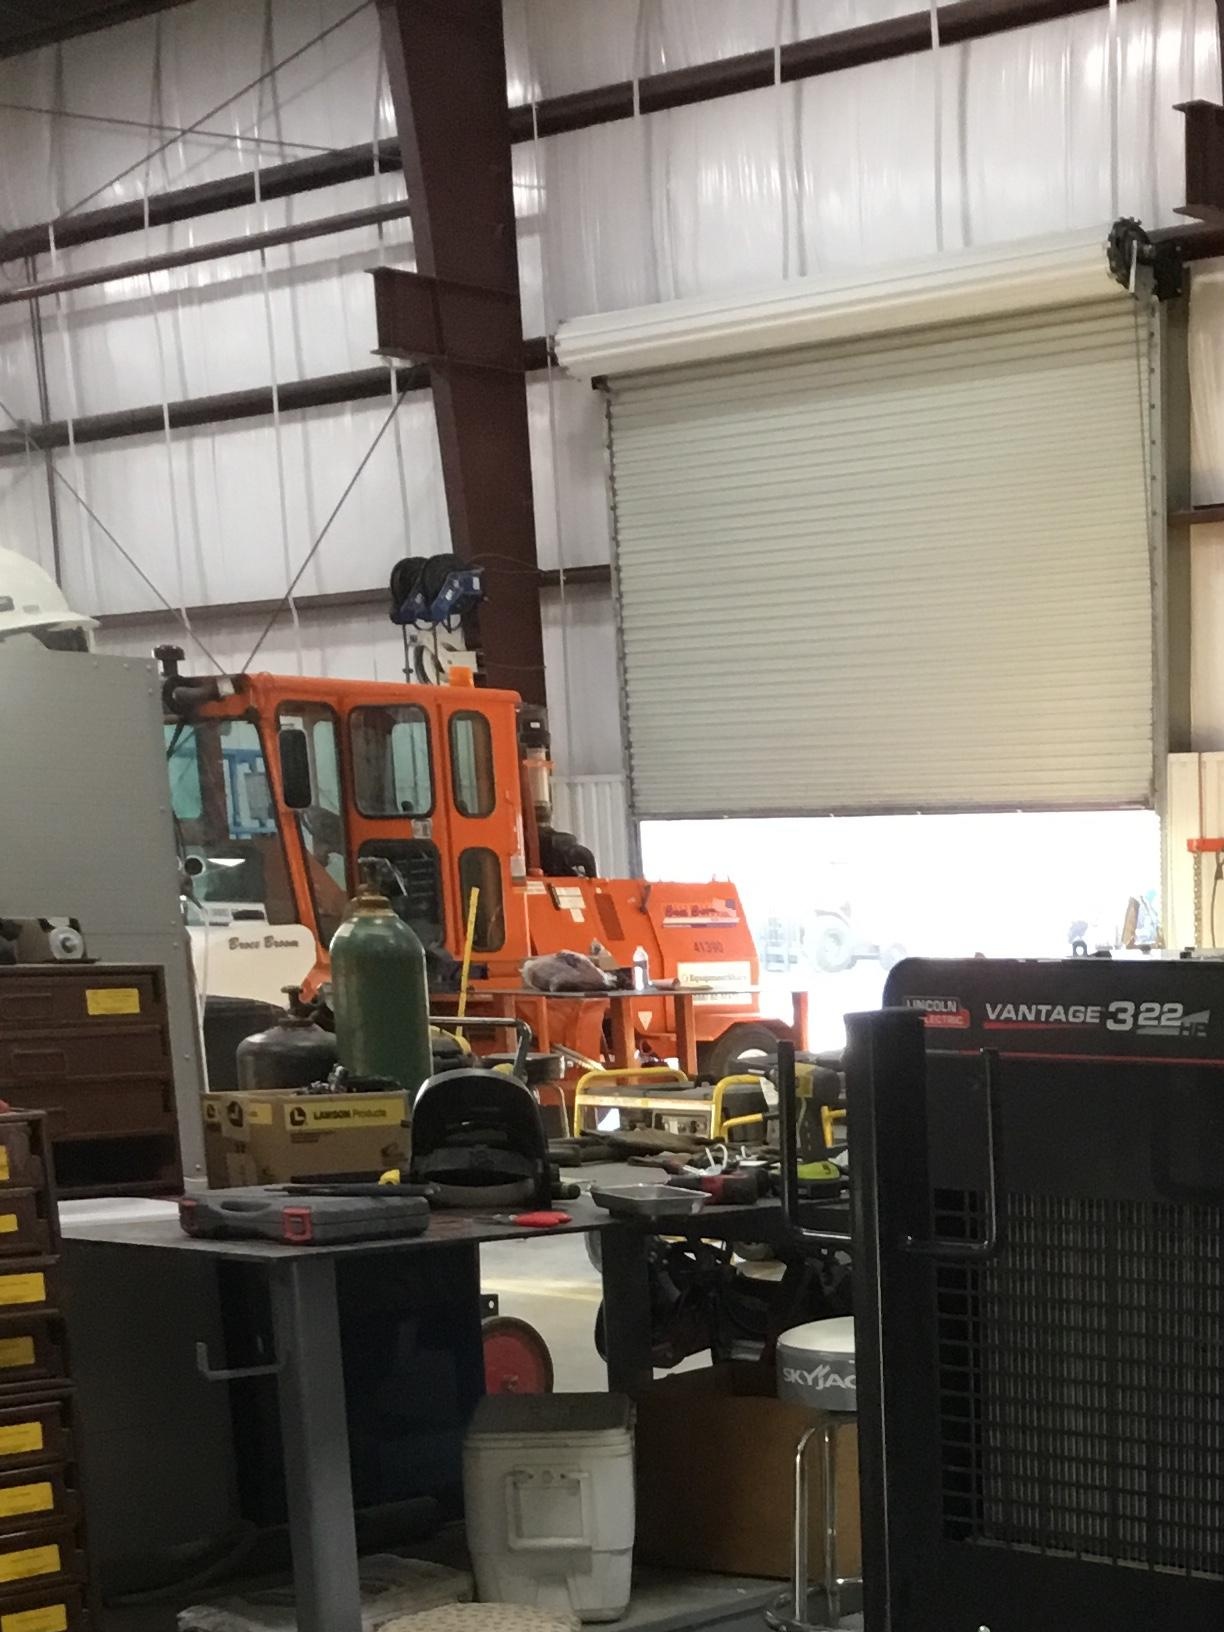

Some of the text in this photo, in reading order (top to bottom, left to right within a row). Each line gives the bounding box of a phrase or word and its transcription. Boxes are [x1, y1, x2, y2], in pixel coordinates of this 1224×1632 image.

[906, 999, 957, 1013] LINCOLN
[985, 1000, 1184, 1032] VANTAGE 322
[922, 1014, 964, 1026] LECTRIC
[782, 1363, 857, 1391] SKYJAC
